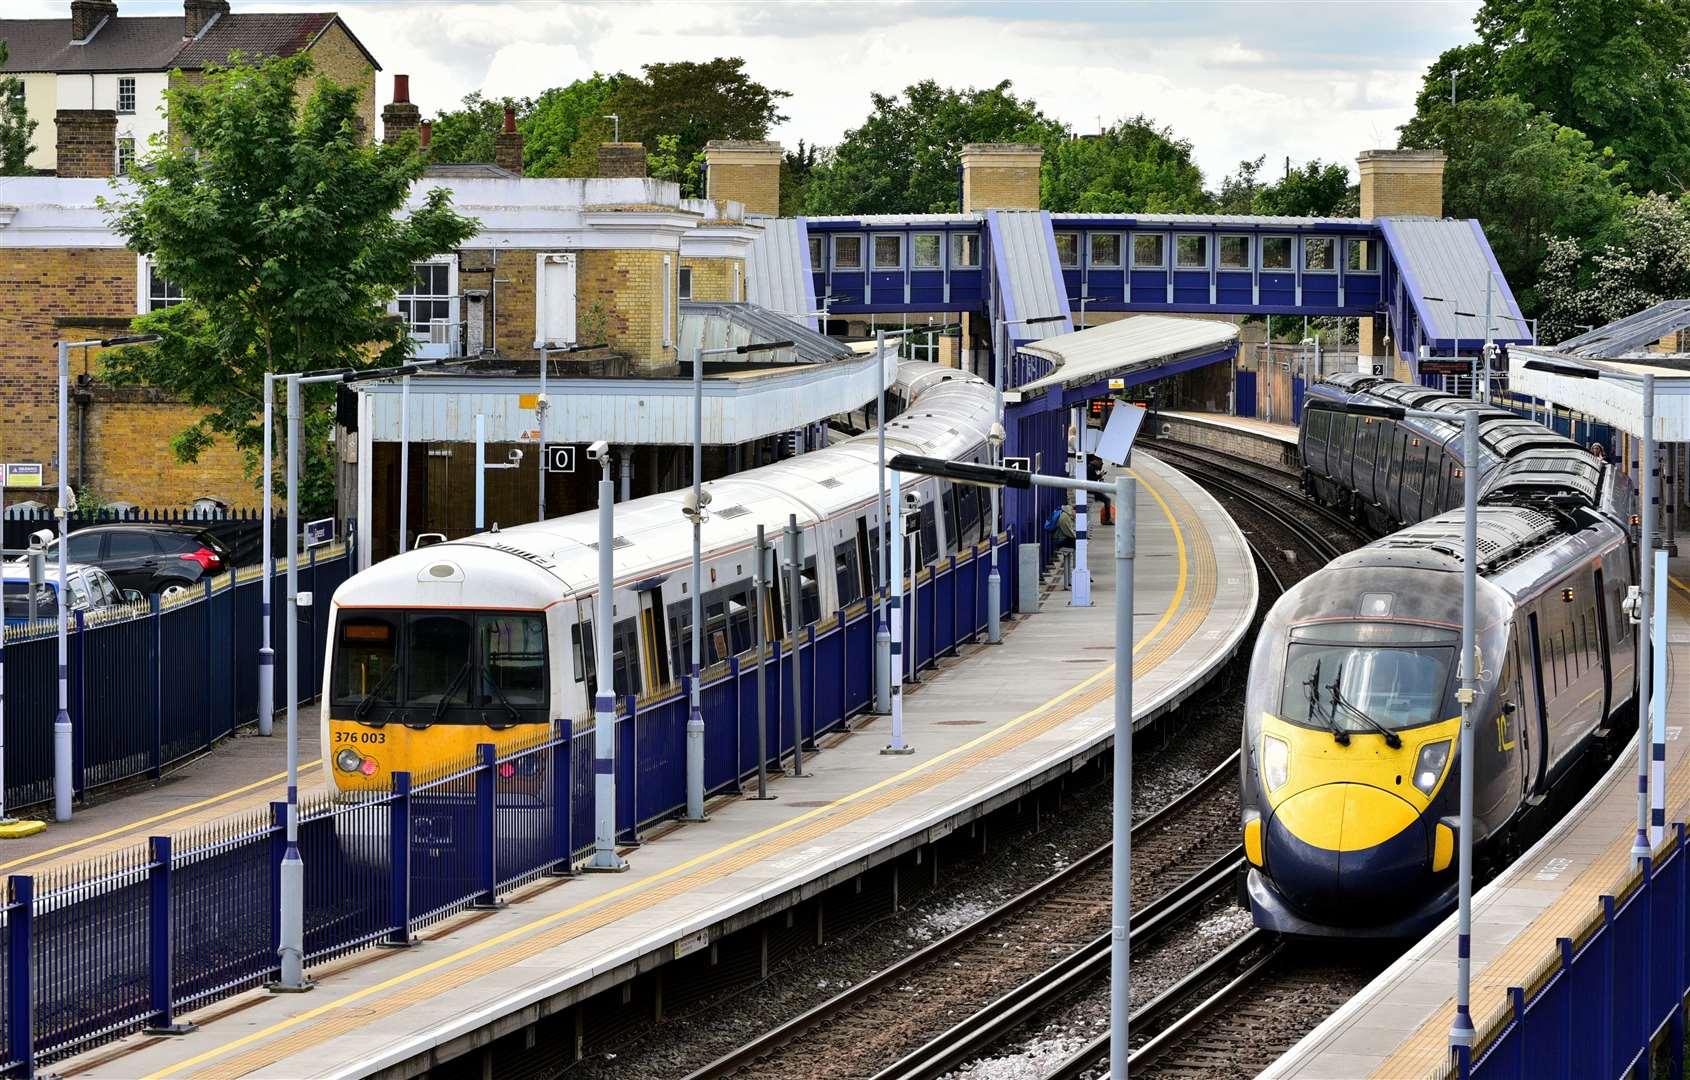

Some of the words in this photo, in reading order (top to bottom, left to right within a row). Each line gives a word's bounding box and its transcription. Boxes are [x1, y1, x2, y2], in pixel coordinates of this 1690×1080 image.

[1374, 365, 1381, 375] 2
[556, 450, 568, 468] 0
[335, 731, 357, 743] 376
[361, 732, 385, 744] 003
